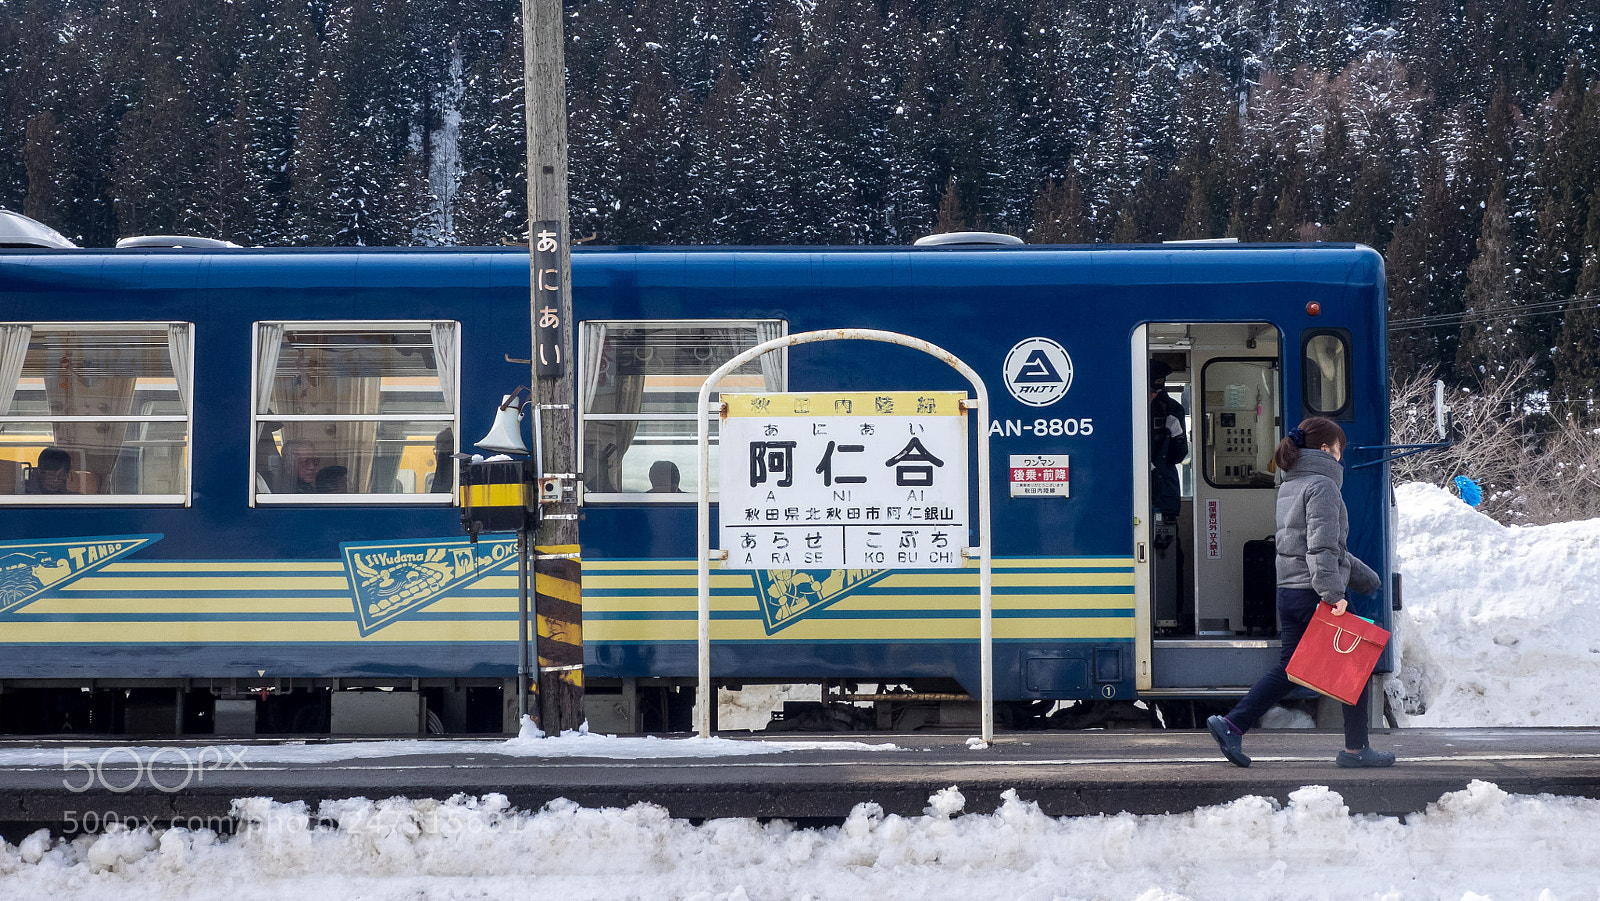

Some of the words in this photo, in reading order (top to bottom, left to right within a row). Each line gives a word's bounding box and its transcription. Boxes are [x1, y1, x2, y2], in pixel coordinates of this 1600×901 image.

[537, 229, 561, 366] あにあい
[763, 422, 925, 437] あにあい
[989, 418, 1094, 437] AN-8805
[749, 436, 945, 487] 阿仁合
[1024, 459, 1055, 467] ワンマン
[766, 490, 776, 502] A
[833, 491, 851, 502] NI
[906, 490, 924, 502] AI
[744, 506, 954, 521] 秋田県北秋田市阿仁銀山
[741, 531, 823, 549] あらせ
[866, 531, 949, 549] こぶち
[67, 543, 122, 570] TANBO
[744, 553, 753, 564] A
[771, 552, 791, 564] RA
[804, 552, 823, 563] SE
[864, 552, 885, 563] KO
[898, 552, 918, 563] BU
[929, 552, 953, 563] CHI
